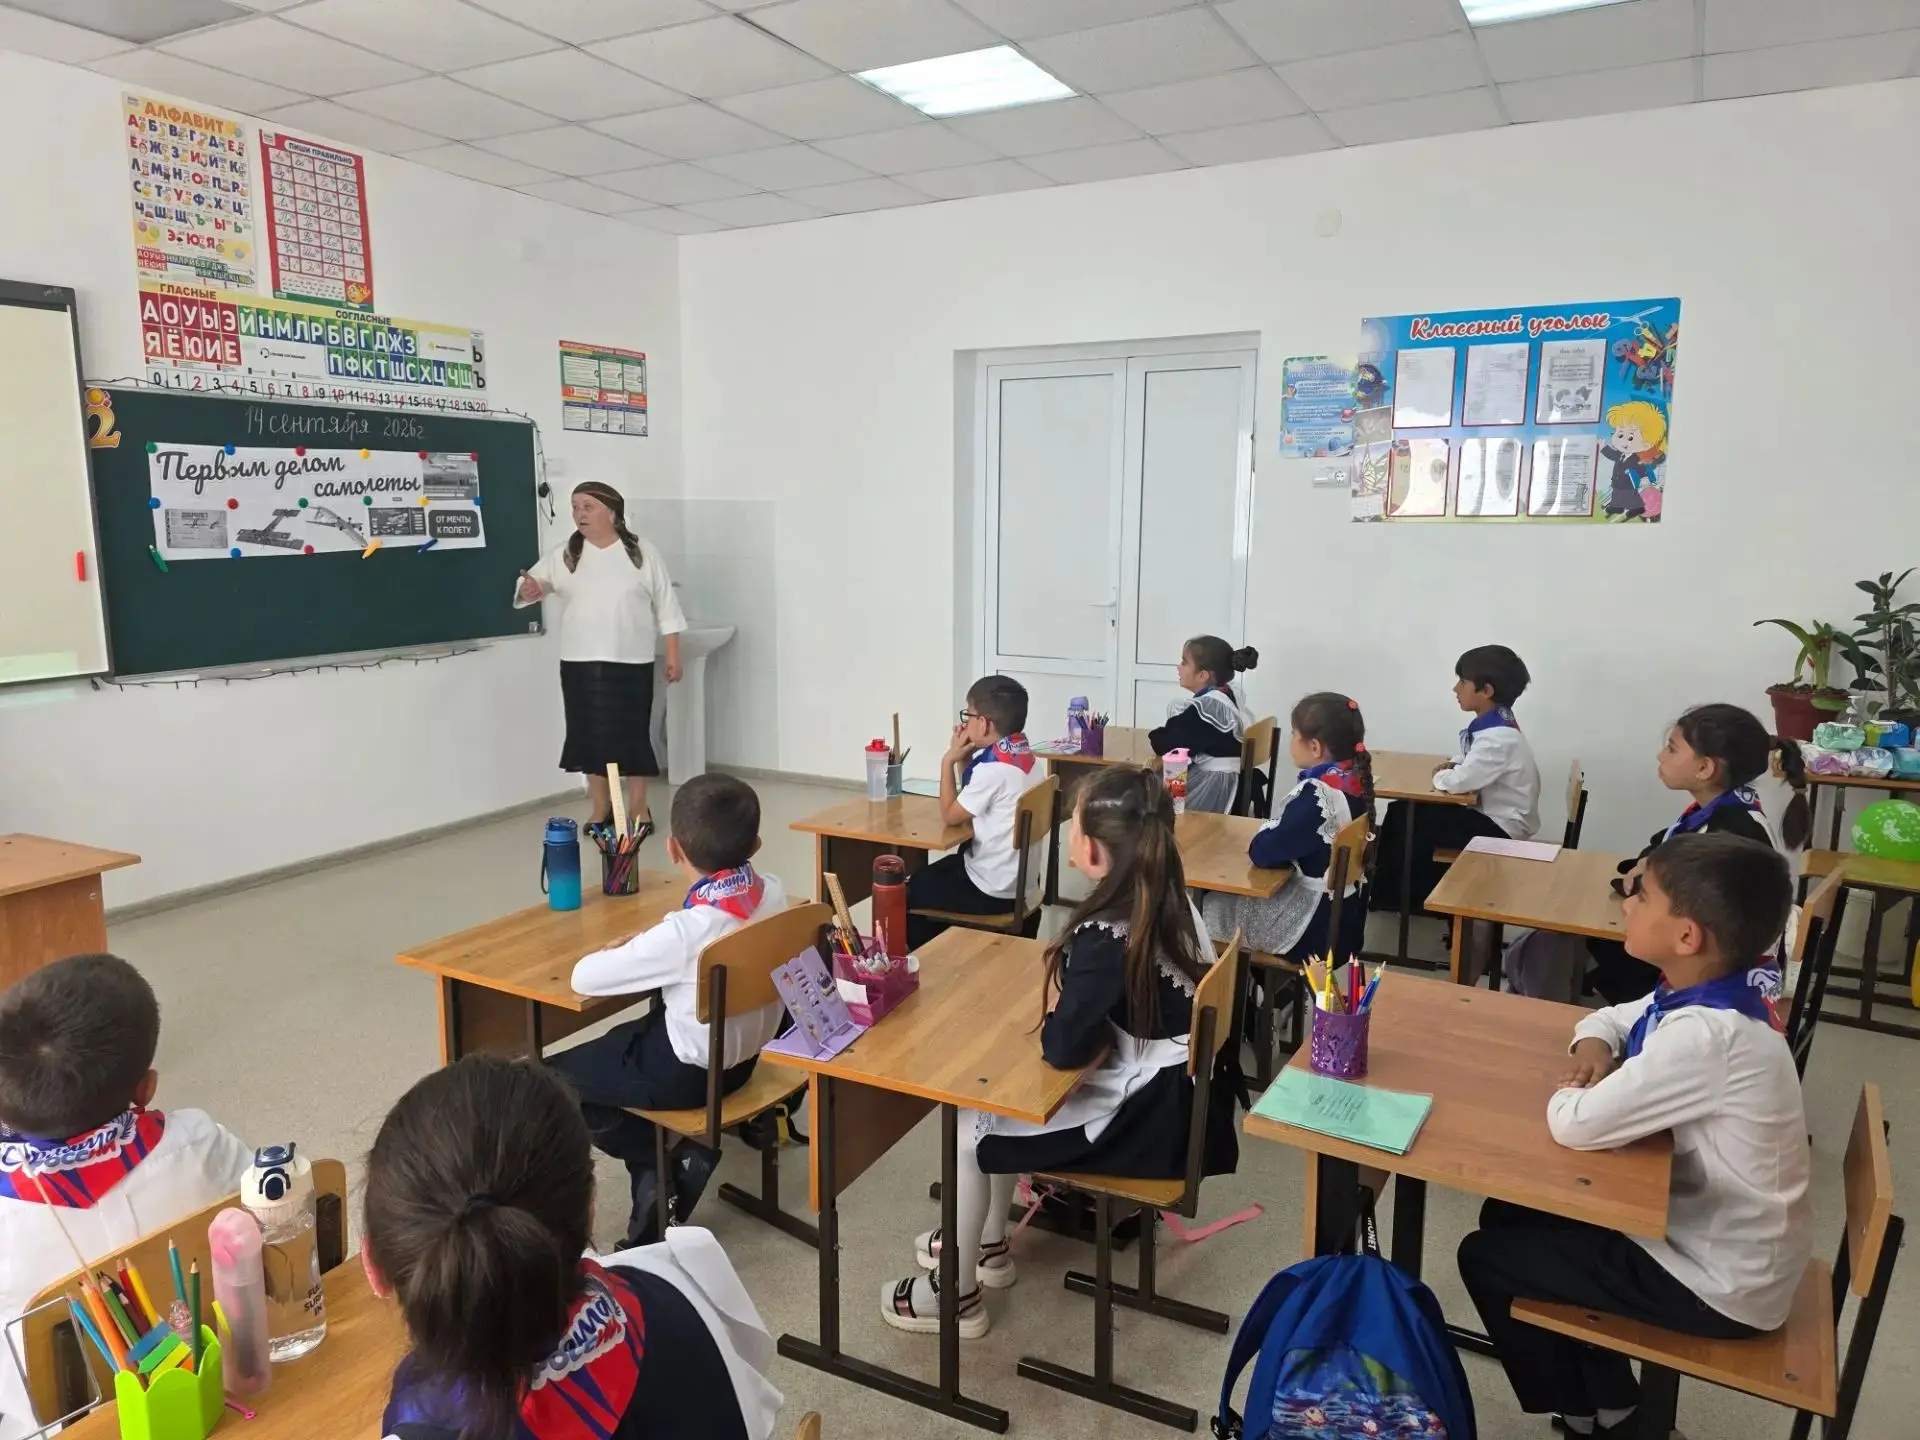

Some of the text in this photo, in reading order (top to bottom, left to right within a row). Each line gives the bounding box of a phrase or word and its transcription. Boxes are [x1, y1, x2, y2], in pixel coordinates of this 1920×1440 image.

[145, 101, 224, 134] АЛФАВИТ
[128, 114, 235, 152] А Б В Г Д Е
[149, 140, 162, 155] Ж
[172, 146, 179, 159] З
[190, 150, 200, 163] И
[229, 160, 239, 173] К
[289, 142, 352, 164] ПИШИ ПРАВИЛЬНО
[131, 158, 240, 192] Л М Н О П Р
[133, 180, 243, 216] С Т У Ф Х Ц
[135, 201, 242, 234] Ч Ш Щ Ъ Ы Ь
[168, 229, 215, 249] Э Ю Я
[160, 283, 217, 300] ГЛАСНЫЕ
[336, 310, 392, 326] СОГЛАСНЫЕ
[1410, 313, 1610, 340] Классный уголок
[472, 345, 483, 363] Ь
[153, 372, 487, 412] 0 1 2 3 4 5 6 7 8 9 10 11 12 13 14 15 16 17 18 19 20
[474, 371, 486, 389] Ъ
[87, 406, 121, 448] 2
[245, 404, 264, 435] 14
[269, 411, 370, 440] сентября
[156, 449, 346, 496] Первым делом
[314, 476, 422, 498] самолеты
[435, 515, 472, 524] ОТ МЕЧТЫ
[436, 526, 472, 534] К ПОЛЕТУ
